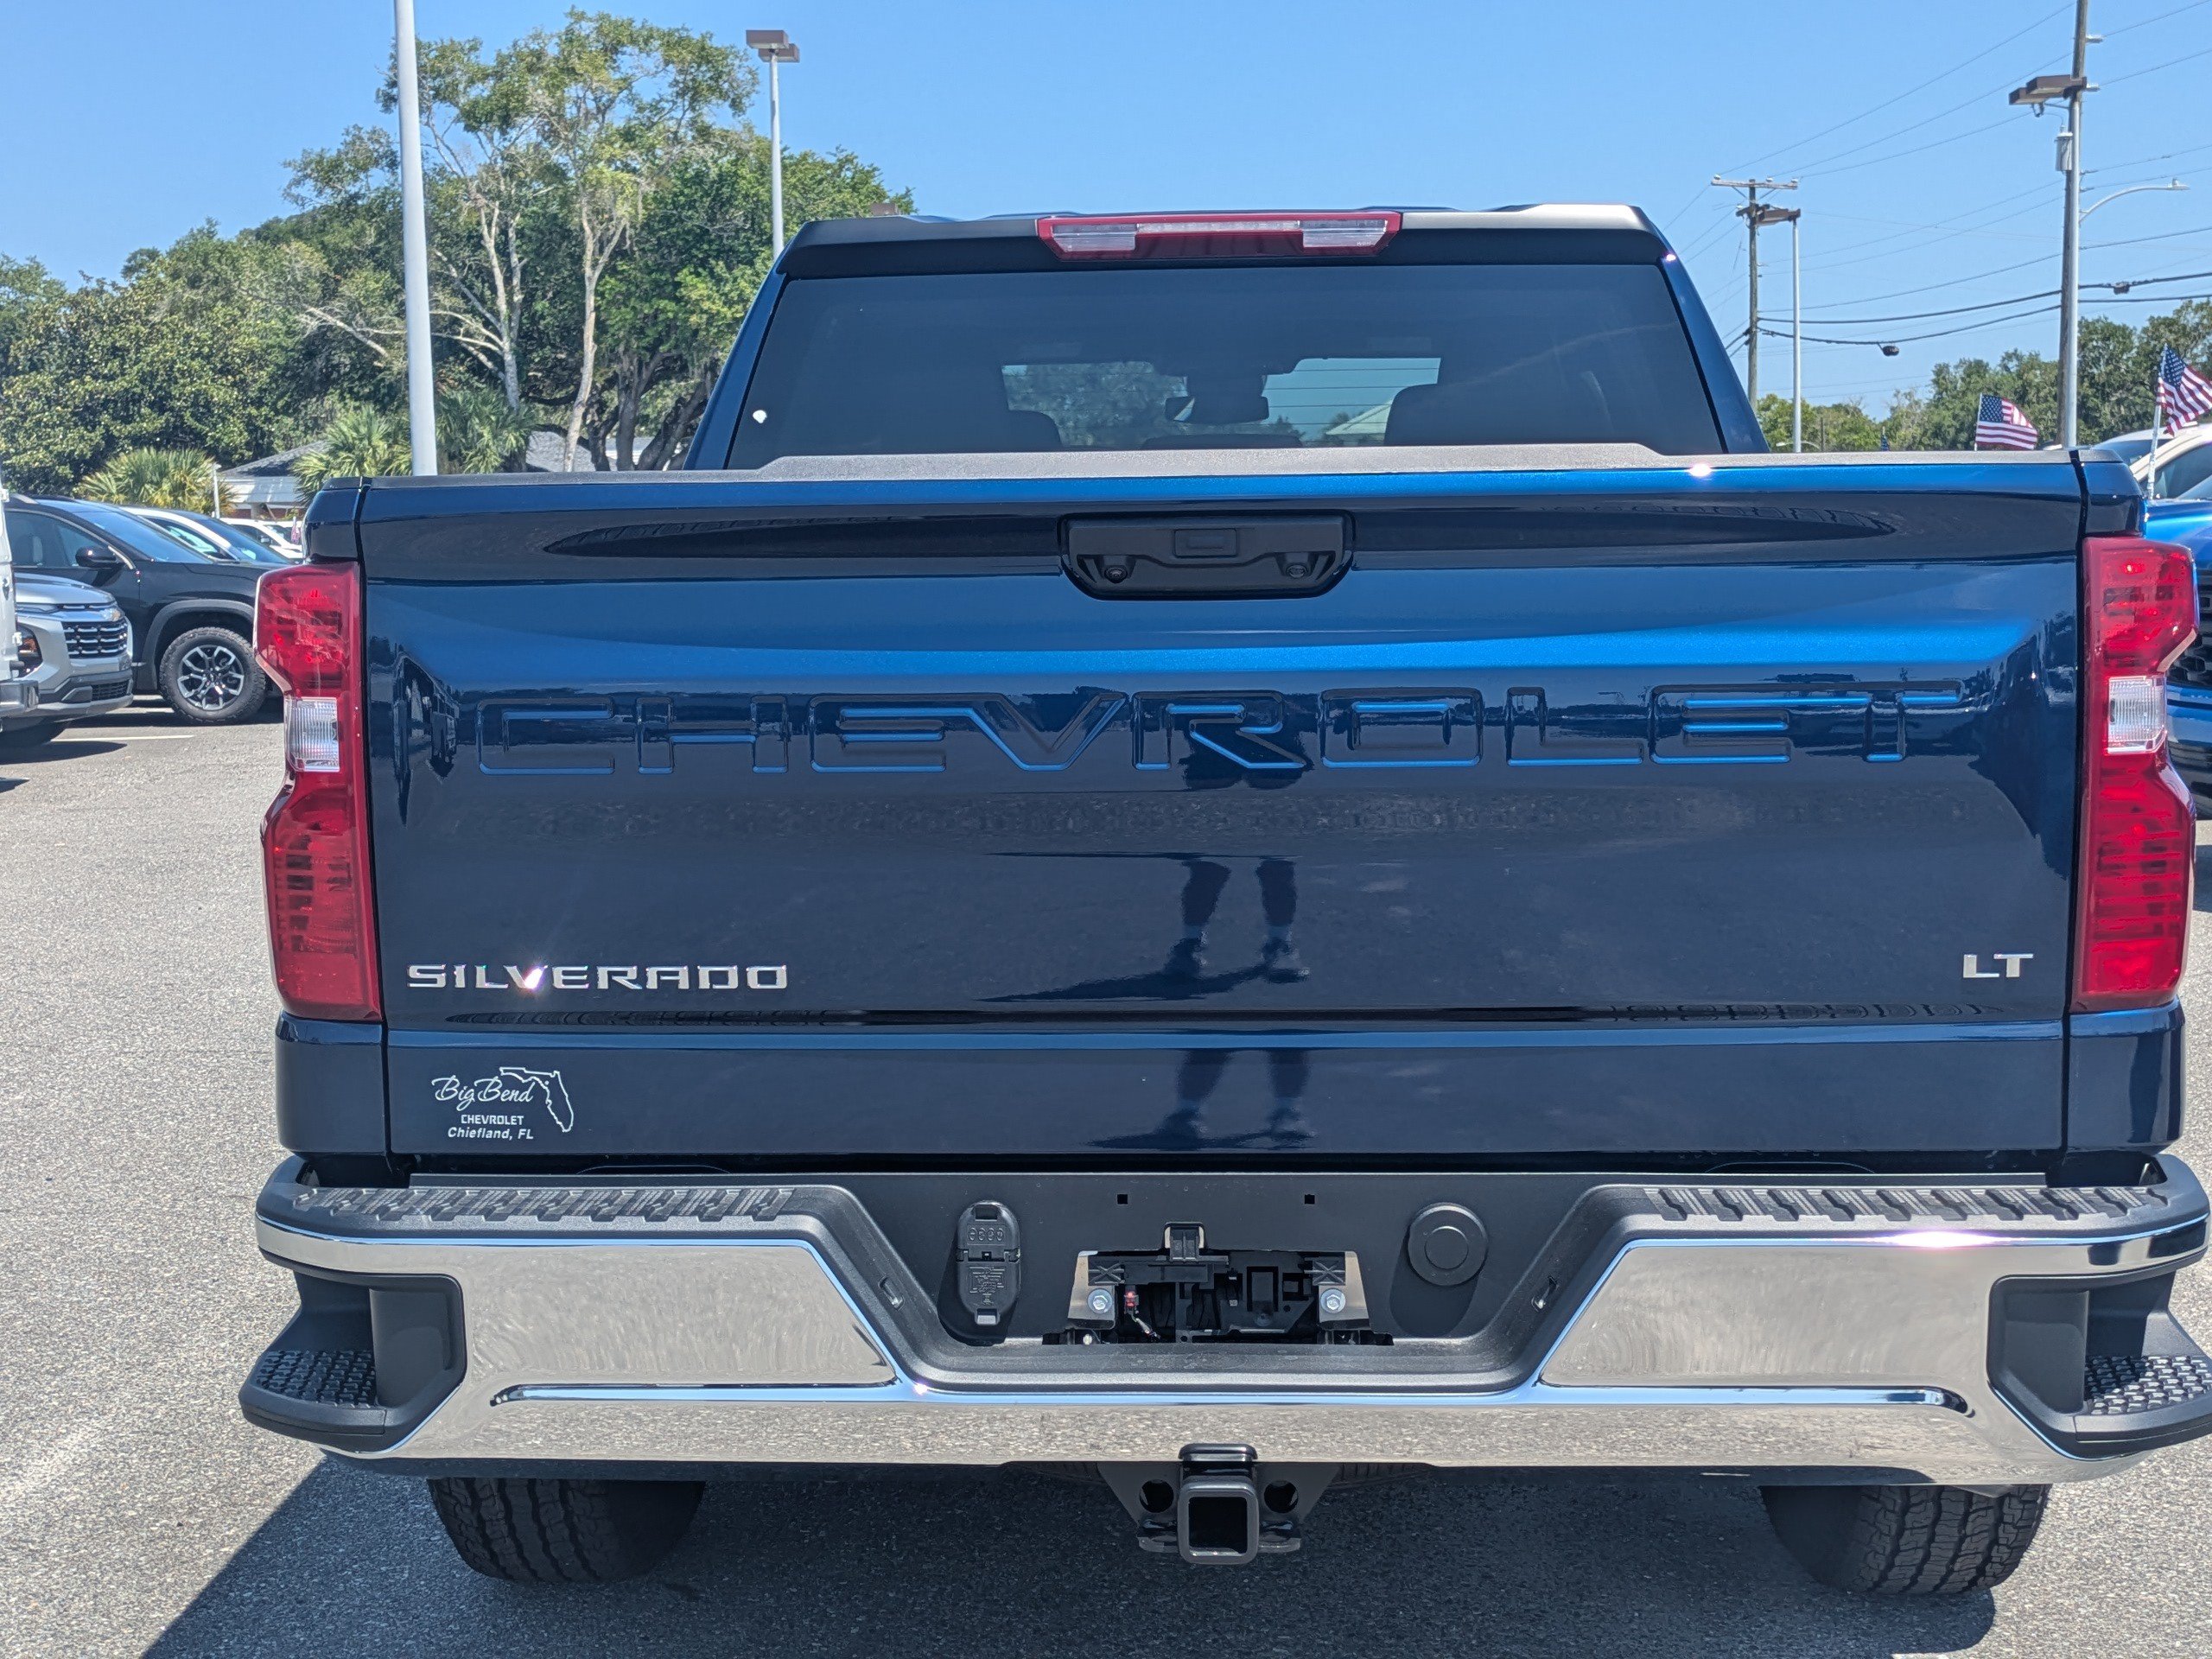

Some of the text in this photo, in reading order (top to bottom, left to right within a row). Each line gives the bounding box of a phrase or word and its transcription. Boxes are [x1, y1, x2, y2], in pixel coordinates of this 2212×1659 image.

[476, 684, 1965, 774] CHEVROLET
[407, 964, 788, 990] SILVERADO
[1962, 953, 2034, 978] LT
[431, 1075, 535, 1111] Big Bend
[461, 1114, 524, 1126] CHEVROLET
[448, 1127, 534, 1141] Chiefland, FL
